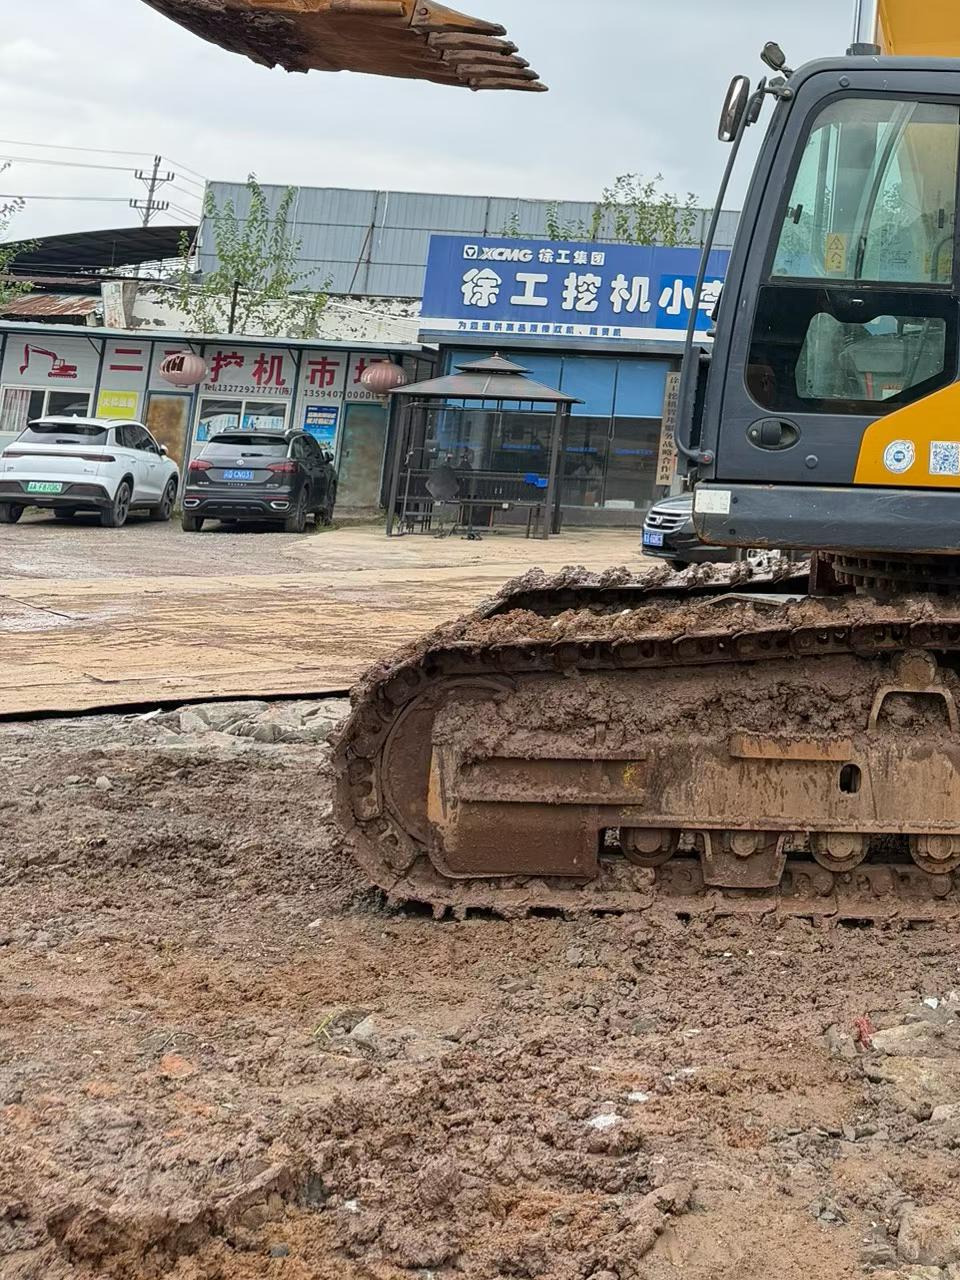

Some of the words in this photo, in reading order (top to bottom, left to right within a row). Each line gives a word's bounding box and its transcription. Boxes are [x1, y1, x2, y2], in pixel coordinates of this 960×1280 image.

[479, 247, 533, 263] XCMG
[538, 247, 606, 266] 徐工集团
[109, 347, 382, 389] 二挖机市
